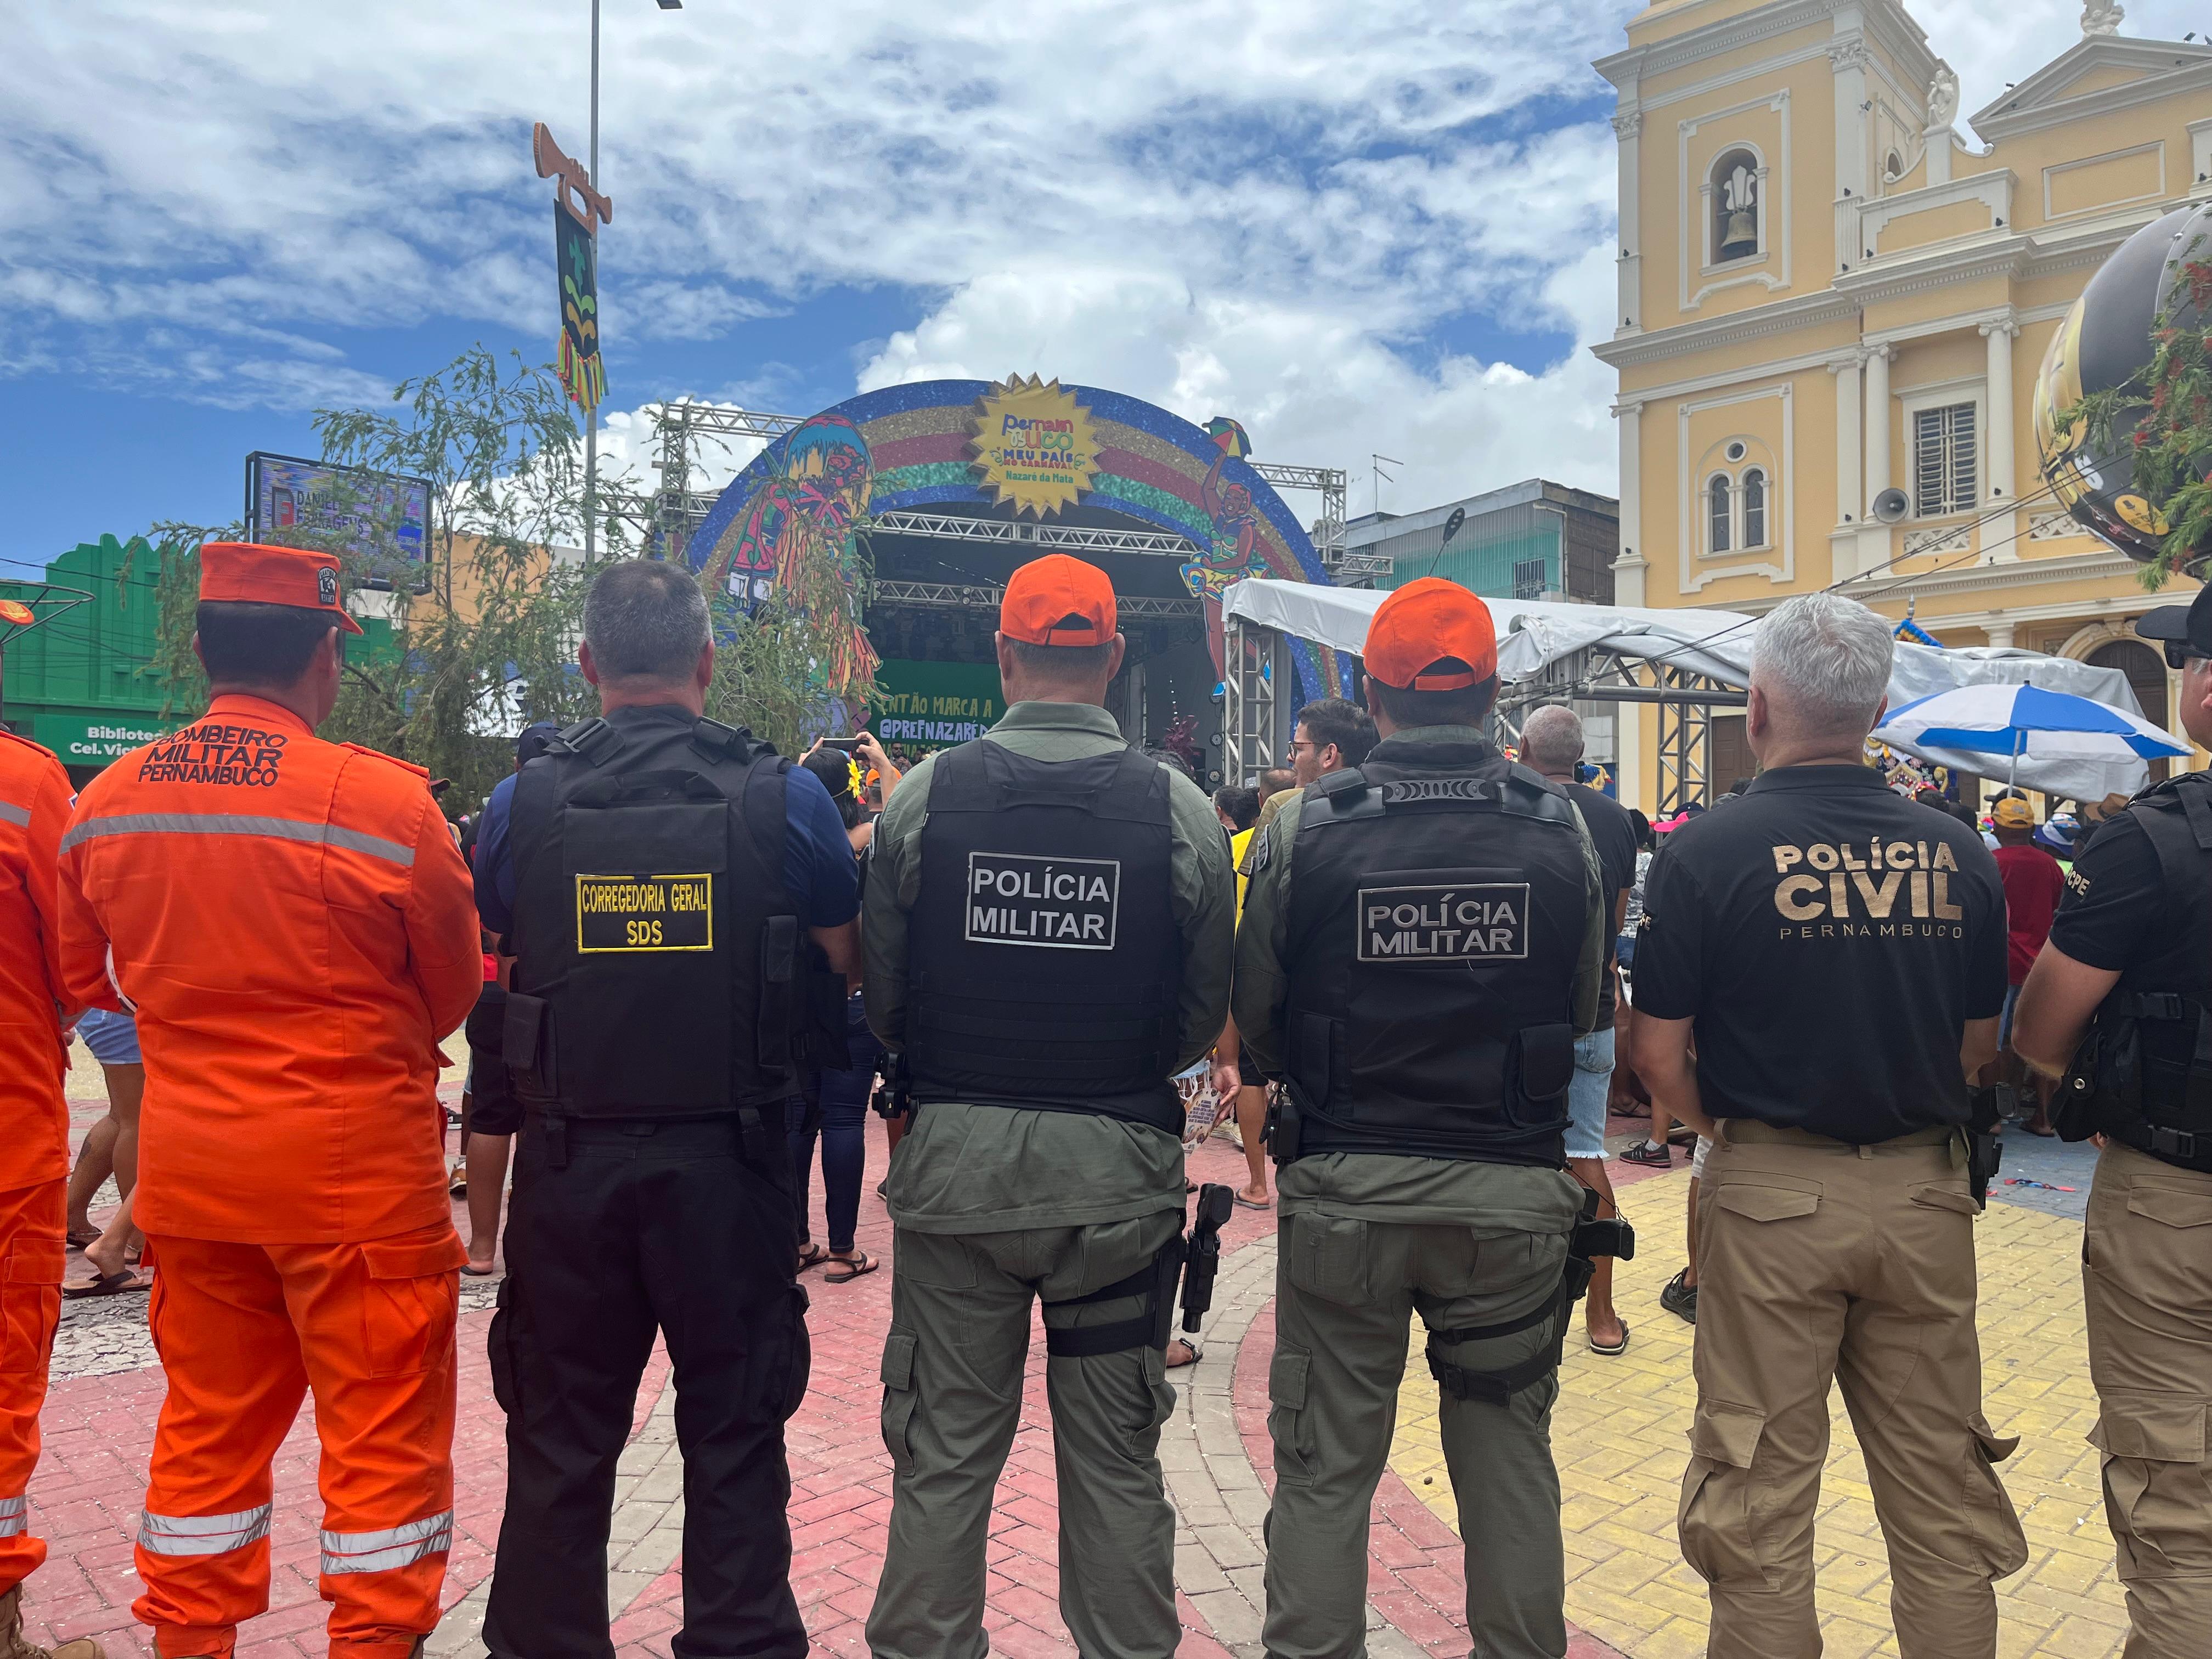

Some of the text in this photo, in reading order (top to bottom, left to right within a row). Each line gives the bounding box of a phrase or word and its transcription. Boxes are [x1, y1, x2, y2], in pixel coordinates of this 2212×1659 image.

[1003, 449, 1074, 462] MEU PAÍS
[1021, 460, 1073, 470] CARNAVAL
[1006, 471, 1074, 483] Nazaré da Mata
[933, 696, 978, 717] MARCA
[983, 699, 992, 718] A
[155, 724, 289, 748] BOMBEIRO
[70, 742, 137, 757] Cel. Vic
[145, 744, 284, 768] MILITAR
[138, 764, 279, 787] PERNAMBUCO
[1772, 836, 1959, 873] POLÍCIA
[974, 866, 1110, 902] POLÍCIA
[1774, 871, 1962, 921] CIVIL
[582, 883, 707, 913] CORREGEDORIA GERAL
[972, 906, 1105, 940] MILITAR
[1368, 893, 1517, 929] POLÍCIA
[627, 920, 663, 945] SDS
[1372, 928, 1513, 955] MILITAR
[1780, 924, 1962, 940] PERNAMBUCO
